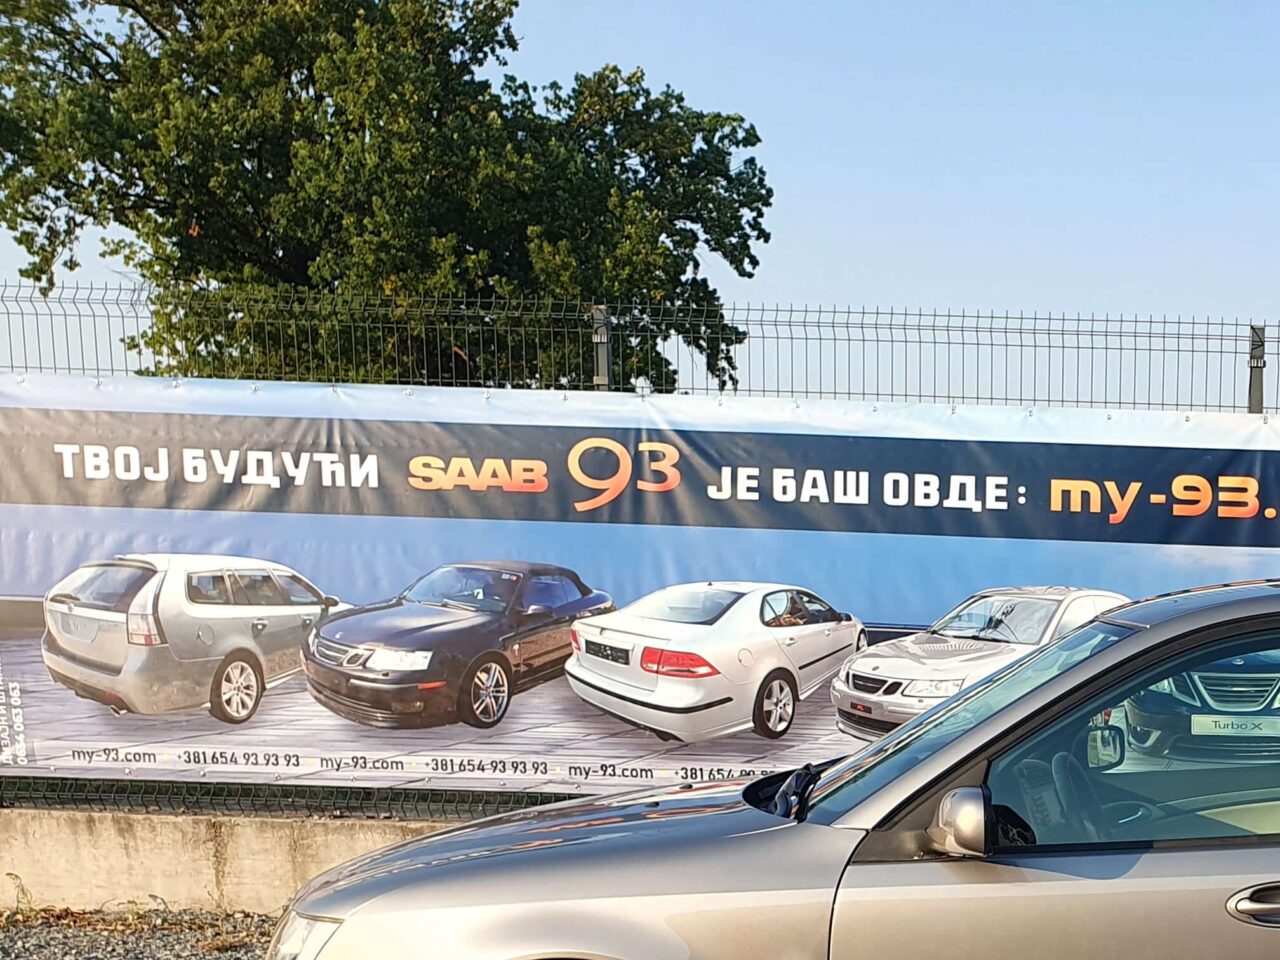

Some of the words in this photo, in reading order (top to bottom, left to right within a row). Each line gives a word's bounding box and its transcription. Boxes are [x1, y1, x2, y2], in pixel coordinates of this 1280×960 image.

[53, 443, 169, 482] ТВОЈ
[182, 448, 379, 489] БУДУЋИ
[407, 455, 549, 494] SAAB
[567, 437, 682, 513] 93
[707, 466, 760, 501] ЈЕ
[772, 468, 869, 505] БАШ
[1211, 720, 1248, 730] Turbo
[1250, 722, 1264, 731] X
[72, 748, 157, 764] my-93.com
[211, 751, 238, 766] 654
[242, 752, 259, 766] 93
[263, 753, 279, 767] 93
[284, 753, 300, 767] 93
[320, 756, 404, 772] my-93.com
[458, 759, 486, 773] 654
[490, 760, 507, 774] 93
[511, 760, 527, 775] 93
[531, 761, 548, 775] 93
[568, 764, 654, 779] my-93.com
